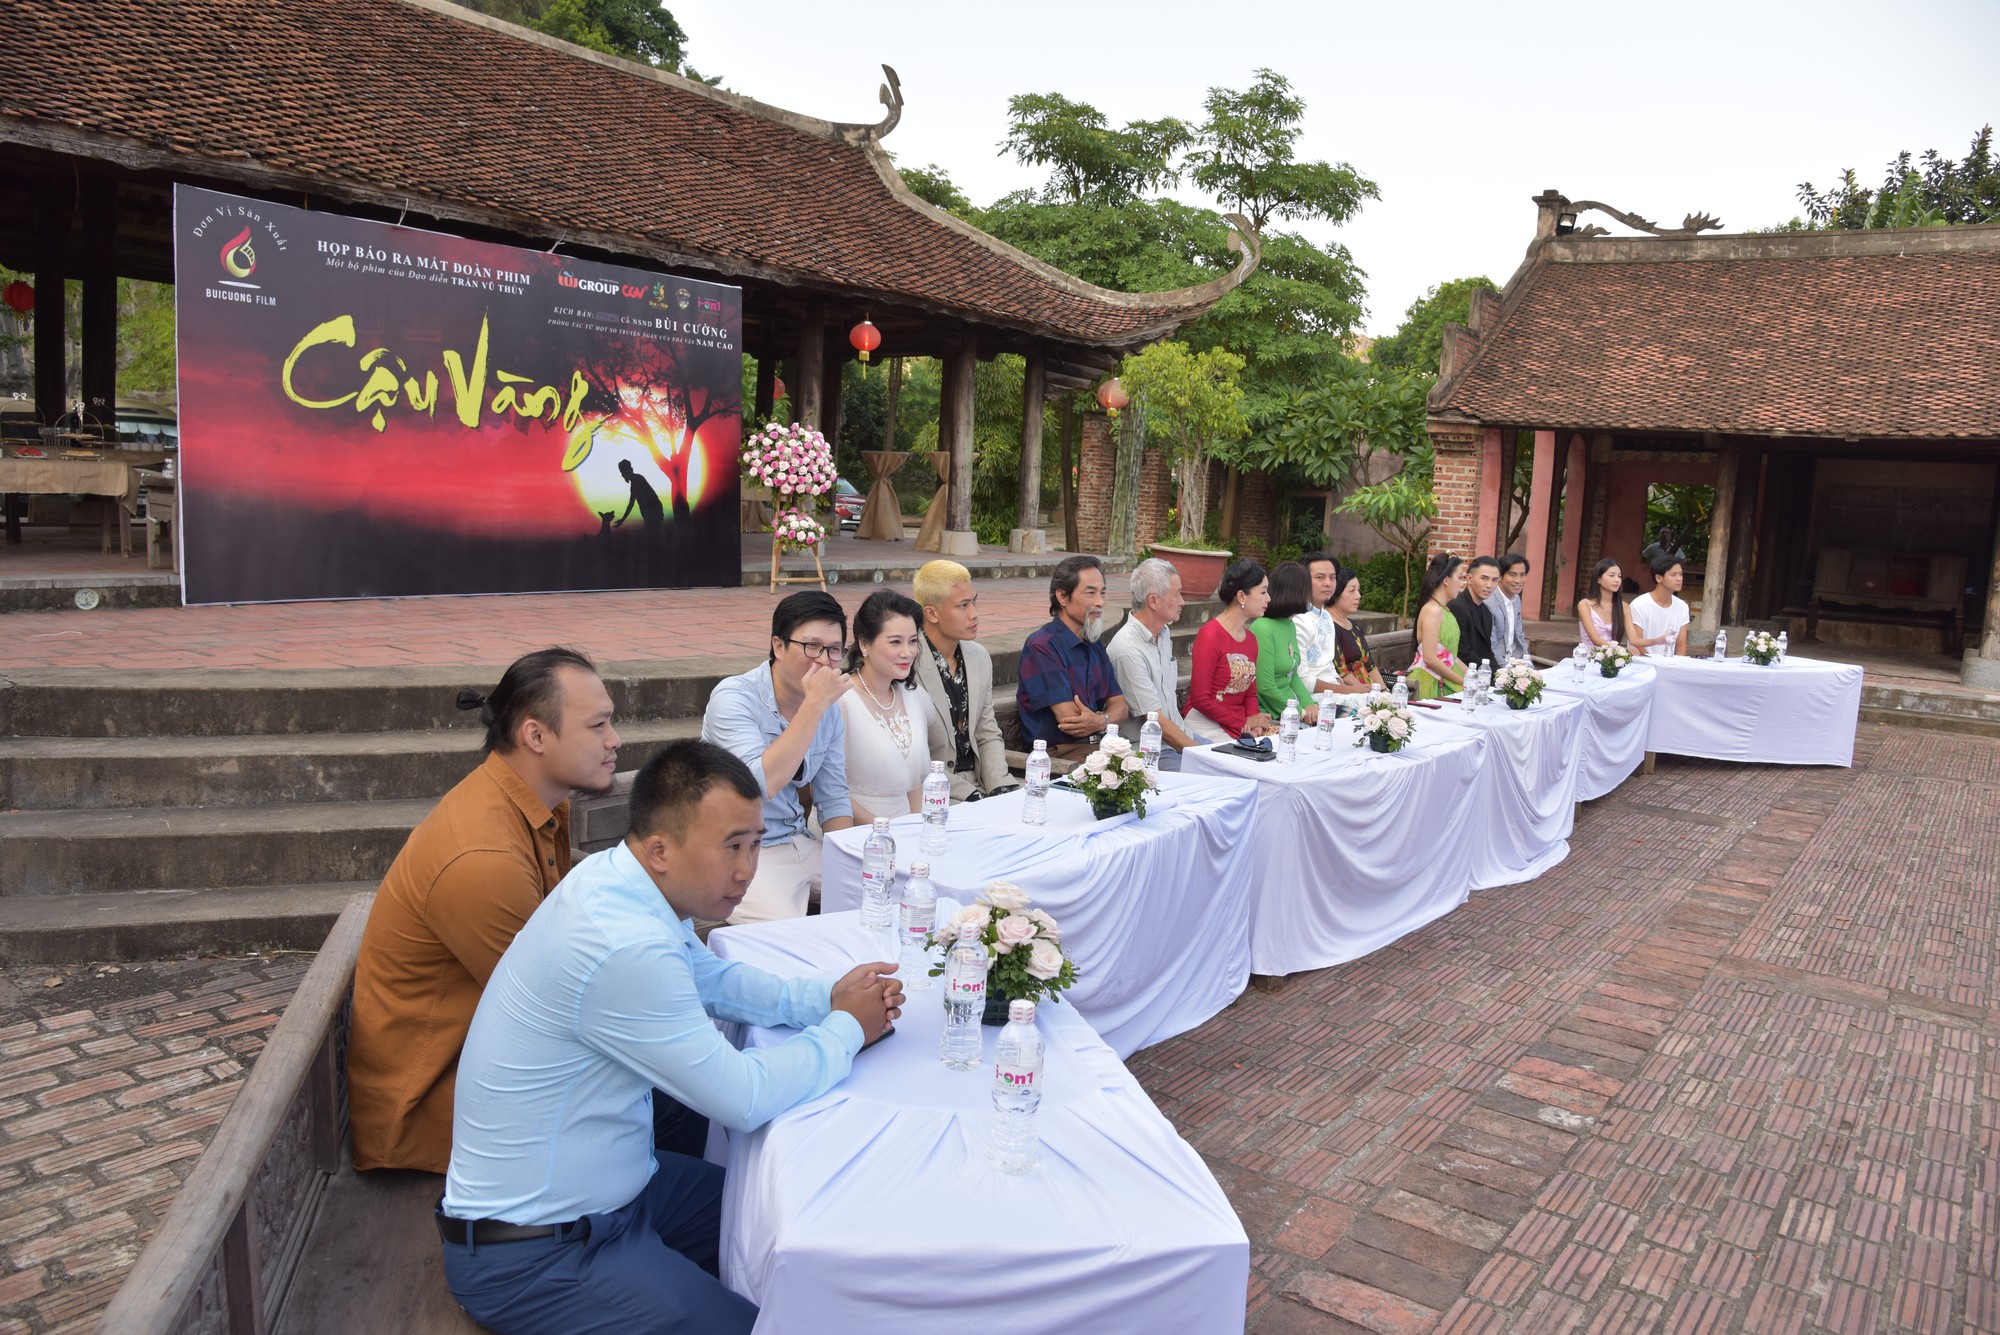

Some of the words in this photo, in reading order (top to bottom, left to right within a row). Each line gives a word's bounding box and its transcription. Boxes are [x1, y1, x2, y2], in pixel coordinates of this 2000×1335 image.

[317, 240, 350, 256] HỌP
[355, 245, 387, 261] BÁO
[392, 252, 412, 266] RA
[453, 262, 491, 278] ĐOÀN
[496, 269, 530, 285] PHIM
[325, 257, 344, 268] Một
[347, 260, 359, 271] bộ
[362, 263, 385, 274] phim
[408, 270, 426, 281] Đạo
[205, 288, 252, 303] BUICUONG
[255, 295, 276, 306] FILM
[620, 284, 646, 299] CGV
[632, 318, 653, 327] NSND
[655, 317, 677, 331] BÙI
[683, 322, 728, 339] CƯỜNG
[696, 338, 714, 348] NAM
[716, 341, 733, 350] CAO
[282, 315, 439, 432] Cậu
[442, 305, 613, 472] Vàng
[924, 795, 946, 805] i-on1
[952, 978, 985, 993] i-on1
[996, 1064, 1033, 1085] i-on1
